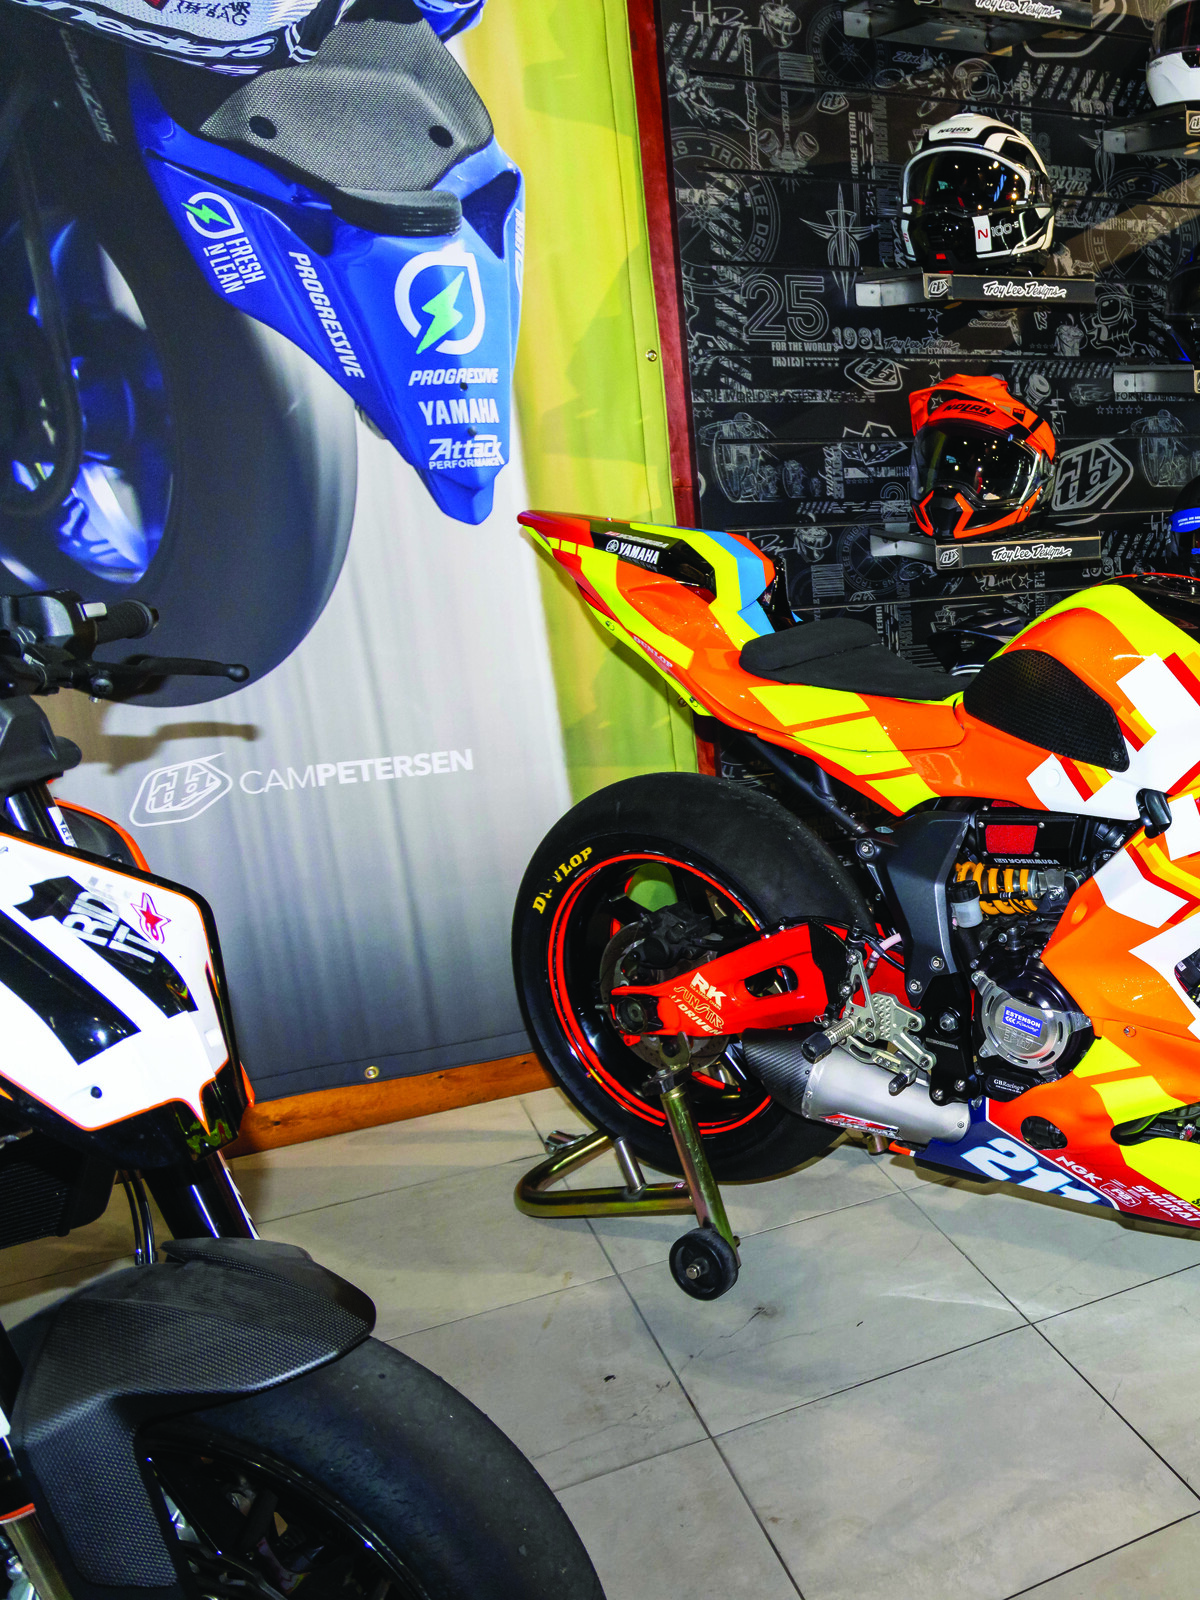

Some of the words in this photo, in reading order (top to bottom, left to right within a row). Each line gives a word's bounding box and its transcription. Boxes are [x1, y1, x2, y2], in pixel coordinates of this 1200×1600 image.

[1016, 0, 1061, 20] Designs
[849, 111, 859, 145] TEAM
[937, 126, 974, 134] NOLAN
[1051, 178, 1089, 192] esigns
[749, 184, 769, 216] LEE
[226, 237, 267, 284] FRESH
[211, 255, 246, 294] LEAN
[982, 280, 1005, 298] Troy
[1006, 281, 1024, 296] Lee
[1024, 280, 1067, 299] Designs
[288, 251, 366, 379] PROGRESSIVE
[740, 273, 830, 342] 25
[771, 342, 789, 351] FOR
[790, 342, 803, 351] THE
[831, 327, 884, 350] 1981
[408, 367, 499, 386] PROGRESSIVE
[1116, 392, 1134, 401] FOR
[418, 398, 500, 426] YAMAHA
[942, 400, 996, 417] NOLAN
[428, 434, 505, 466] Attack
[428, 460, 501, 470] PERFORMANCE
[618, 541, 660, 565] YAMAHA
[991, 547, 1014, 562] Troy
[1014, 547, 1031, 559] Lee
[1031, 544, 1072, 561] Designs
[1008, 858, 1061, 866] YOSHIMURA
[689, 972, 727, 1009] RK
[673, 986, 725, 1029] SUNSTAR
[678, 1003, 724, 1035] DRIVEN
[1005, 1009, 1041, 1028] ESTENSON
[1055, 1156, 1103, 1183] NGK
